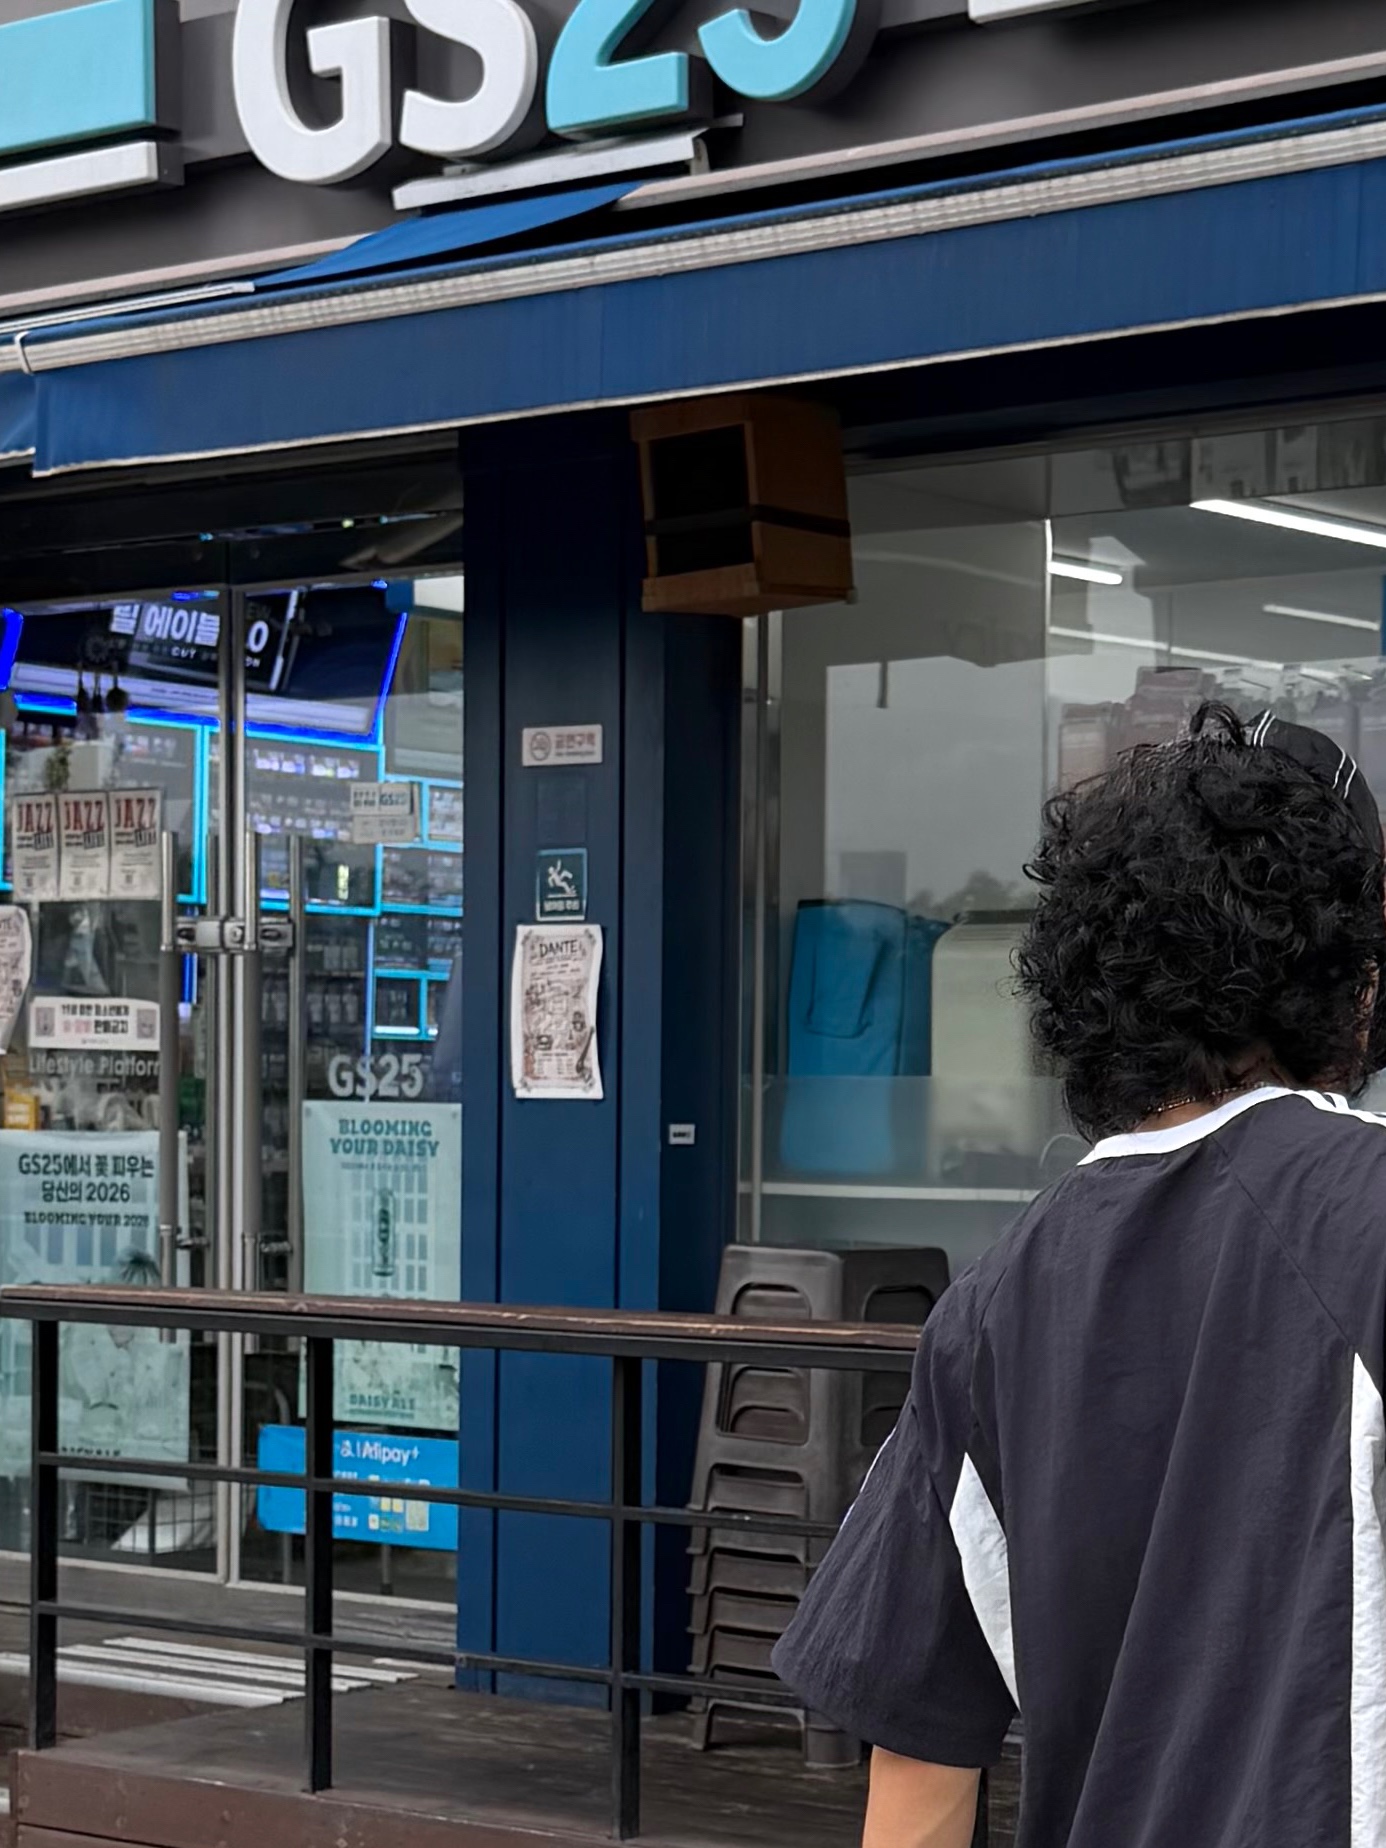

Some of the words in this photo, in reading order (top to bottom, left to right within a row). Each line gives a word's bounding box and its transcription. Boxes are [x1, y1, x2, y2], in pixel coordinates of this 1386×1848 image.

[144, 605, 221, 647] 에이블
[17, 801, 54, 832] JAZZ
[64, 800, 105, 832] JAZZ
[115, 797, 157, 829] JAZZ
[539, 939, 578, 959] DANTE
[29, 1052, 94, 1078] Lifestyle
[328, 1053, 424, 1097] GS25
[338, 1119, 433, 1136] BLOOMING
[329, 1138, 378, 1155] YOUR
[383, 1140, 440, 1157] DAISY
[18, 1153, 91, 1176] GS25에서
[95, 1154, 109, 1177] 꽃
[112, 1155, 154, 1178] 피우는
[42, 1180, 83, 1203] 당신의
[86, 1182, 131, 1203] 2026
[88, 1213, 121, 1226] YOUR
[349, 1393, 389, 1408] DAISY
